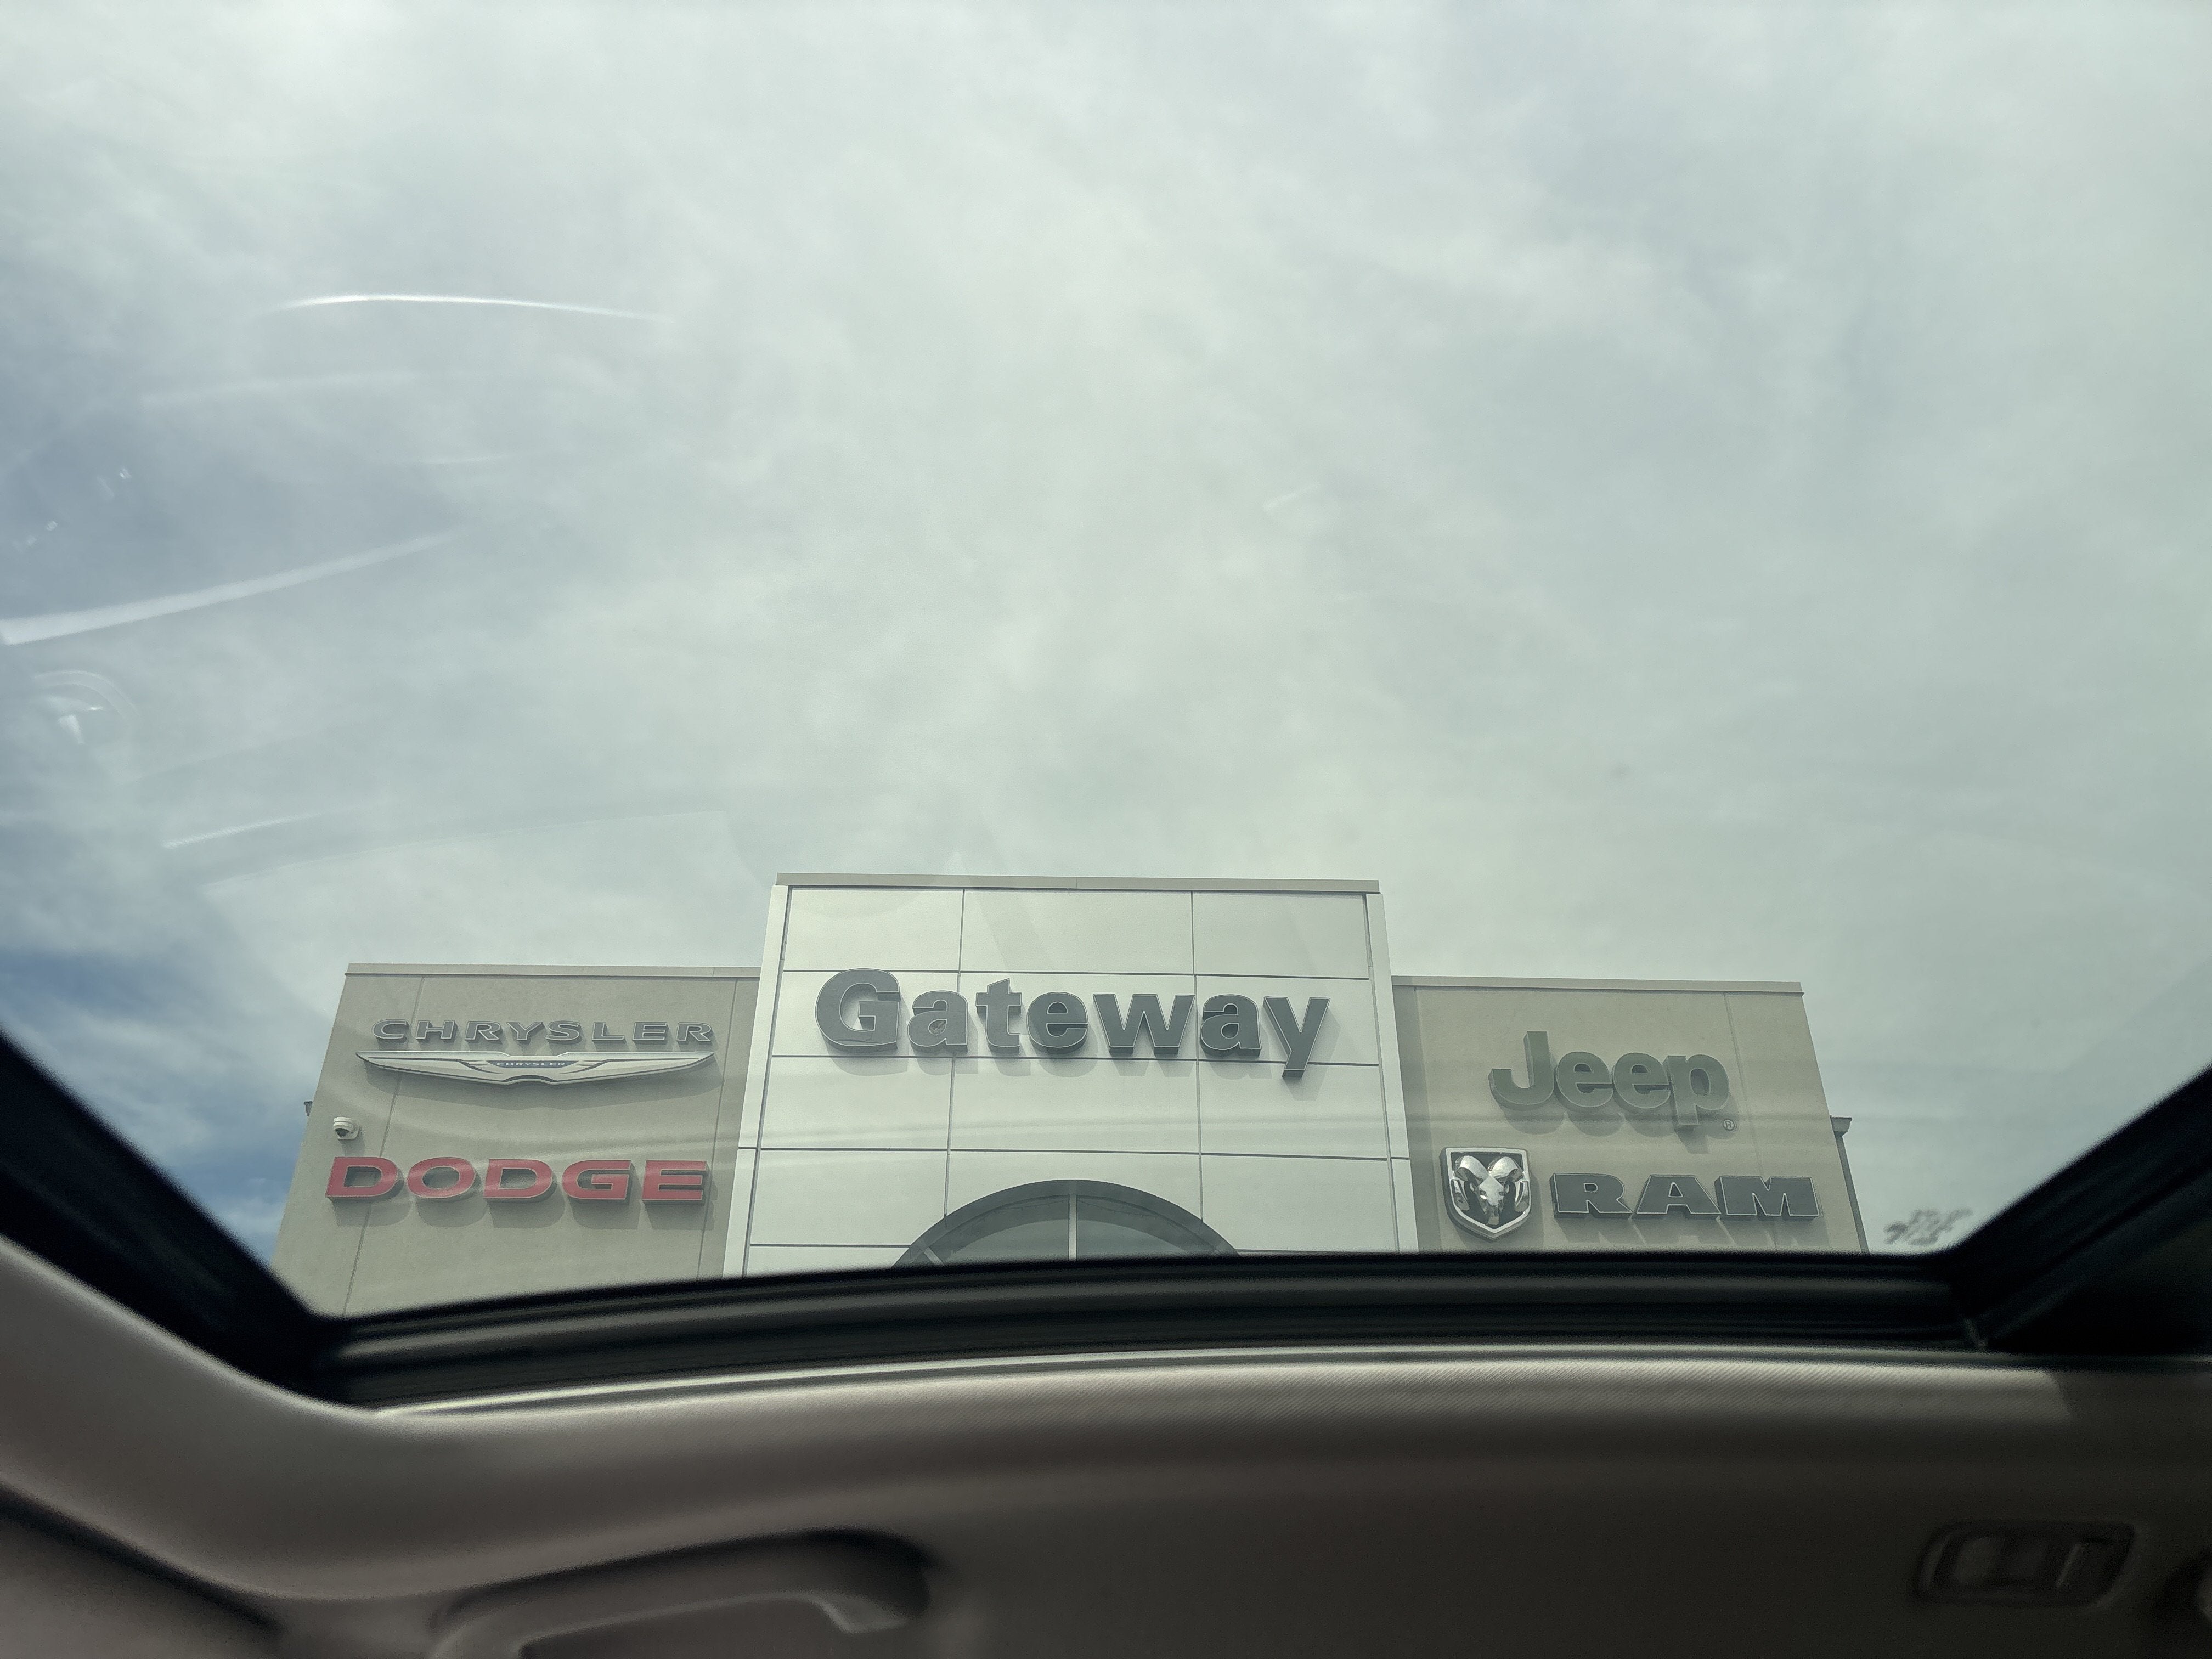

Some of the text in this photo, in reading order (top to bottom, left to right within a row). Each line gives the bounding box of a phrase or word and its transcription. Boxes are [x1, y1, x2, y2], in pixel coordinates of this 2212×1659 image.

[371, 1018, 714, 1043] CHRYSLER
[815, 968, 1330, 1078] Gateway
[325, 1156, 708, 1201] DODGE
[1550, 1172, 1822, 1218] RAM
